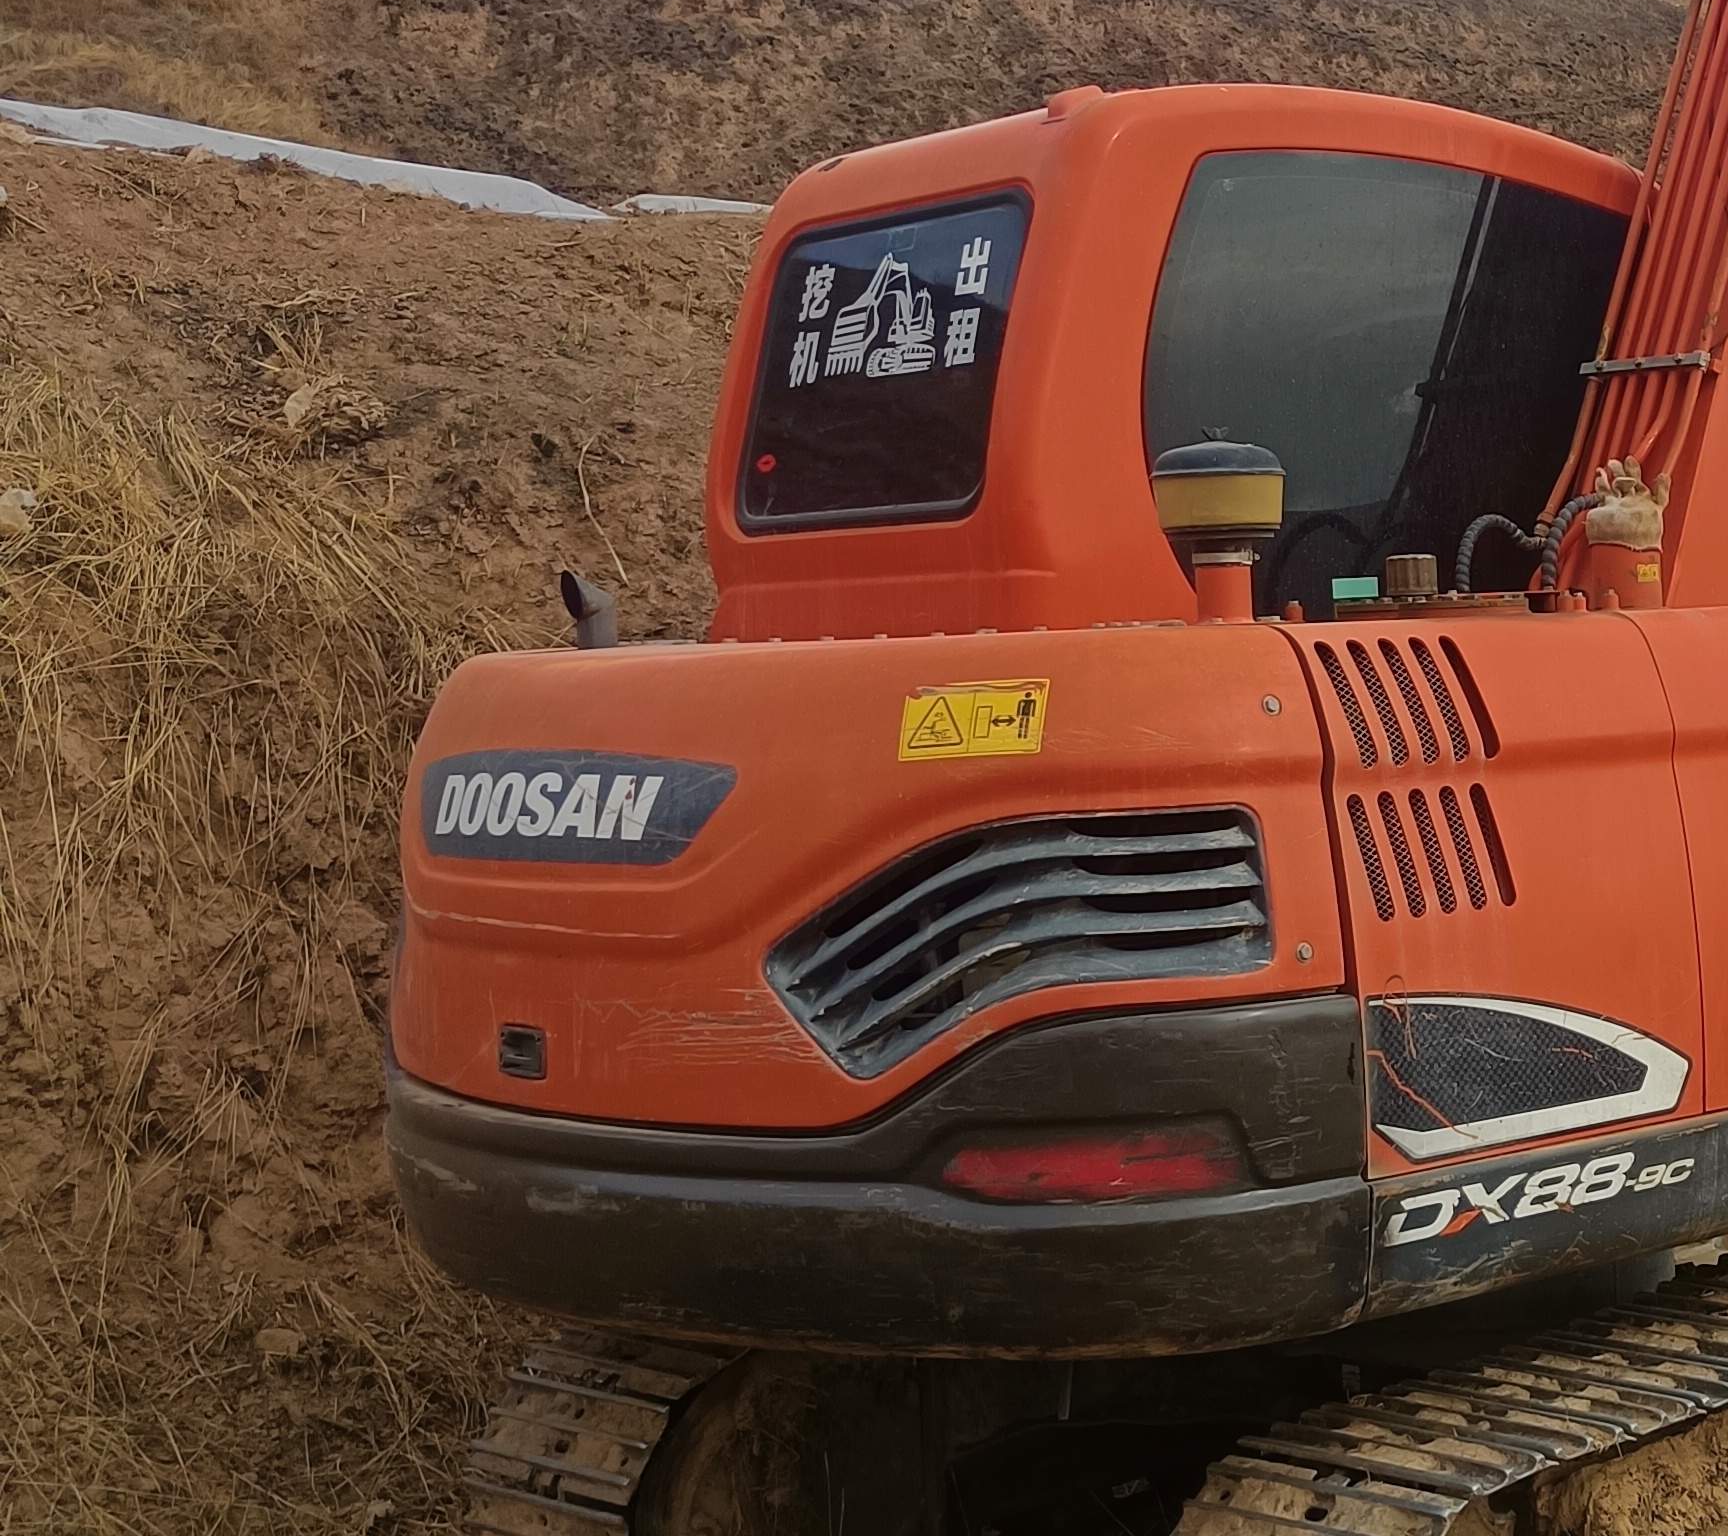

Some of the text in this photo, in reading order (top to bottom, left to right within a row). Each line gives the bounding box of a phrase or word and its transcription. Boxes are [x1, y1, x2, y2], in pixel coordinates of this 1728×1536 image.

[789, 264, 836, 388] 挖机
[944, 236, 993, 368] 出租
[435, 771, 665, 841] DOOSAN
